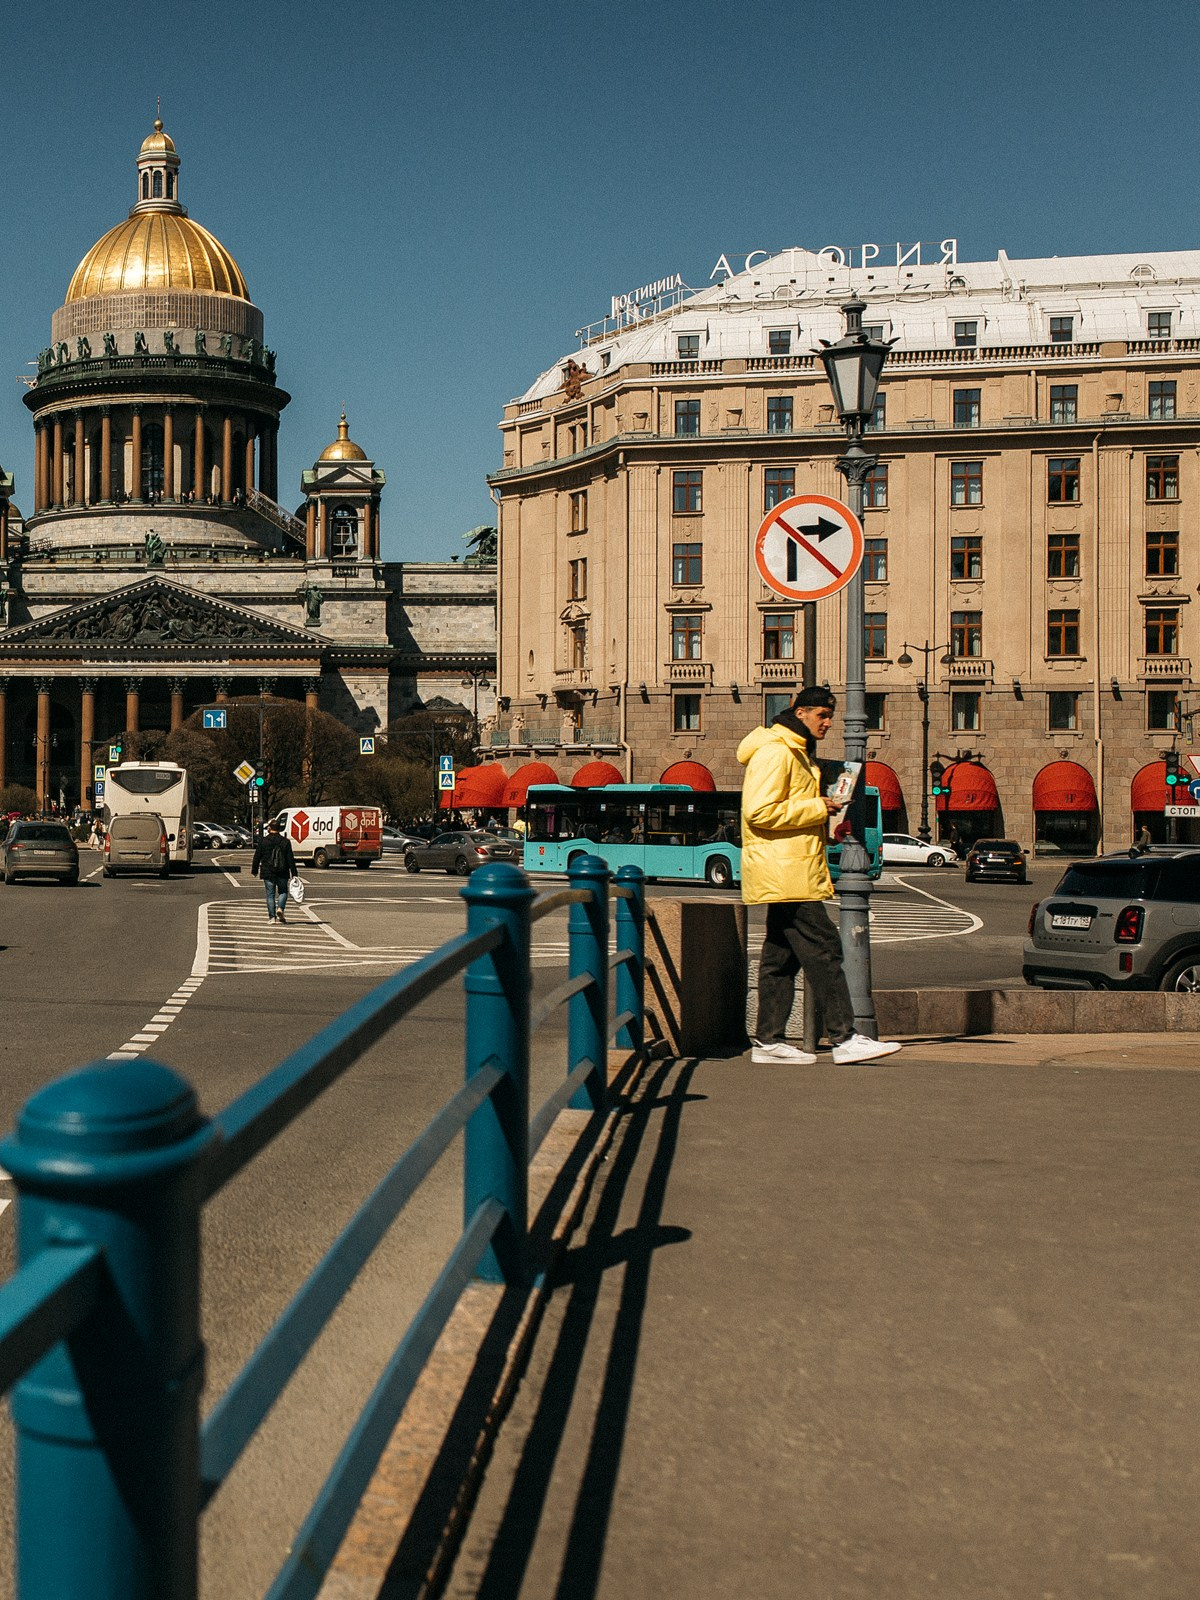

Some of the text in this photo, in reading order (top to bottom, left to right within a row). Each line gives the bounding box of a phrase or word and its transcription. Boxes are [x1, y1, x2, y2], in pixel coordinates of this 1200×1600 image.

[709, 238, 958, 280] АСТОРИЯ
[1169, 807, 1196, 815] СТОП
[312, 816, 334, 835] dpd
[360, 817, 375, 828] dpd
